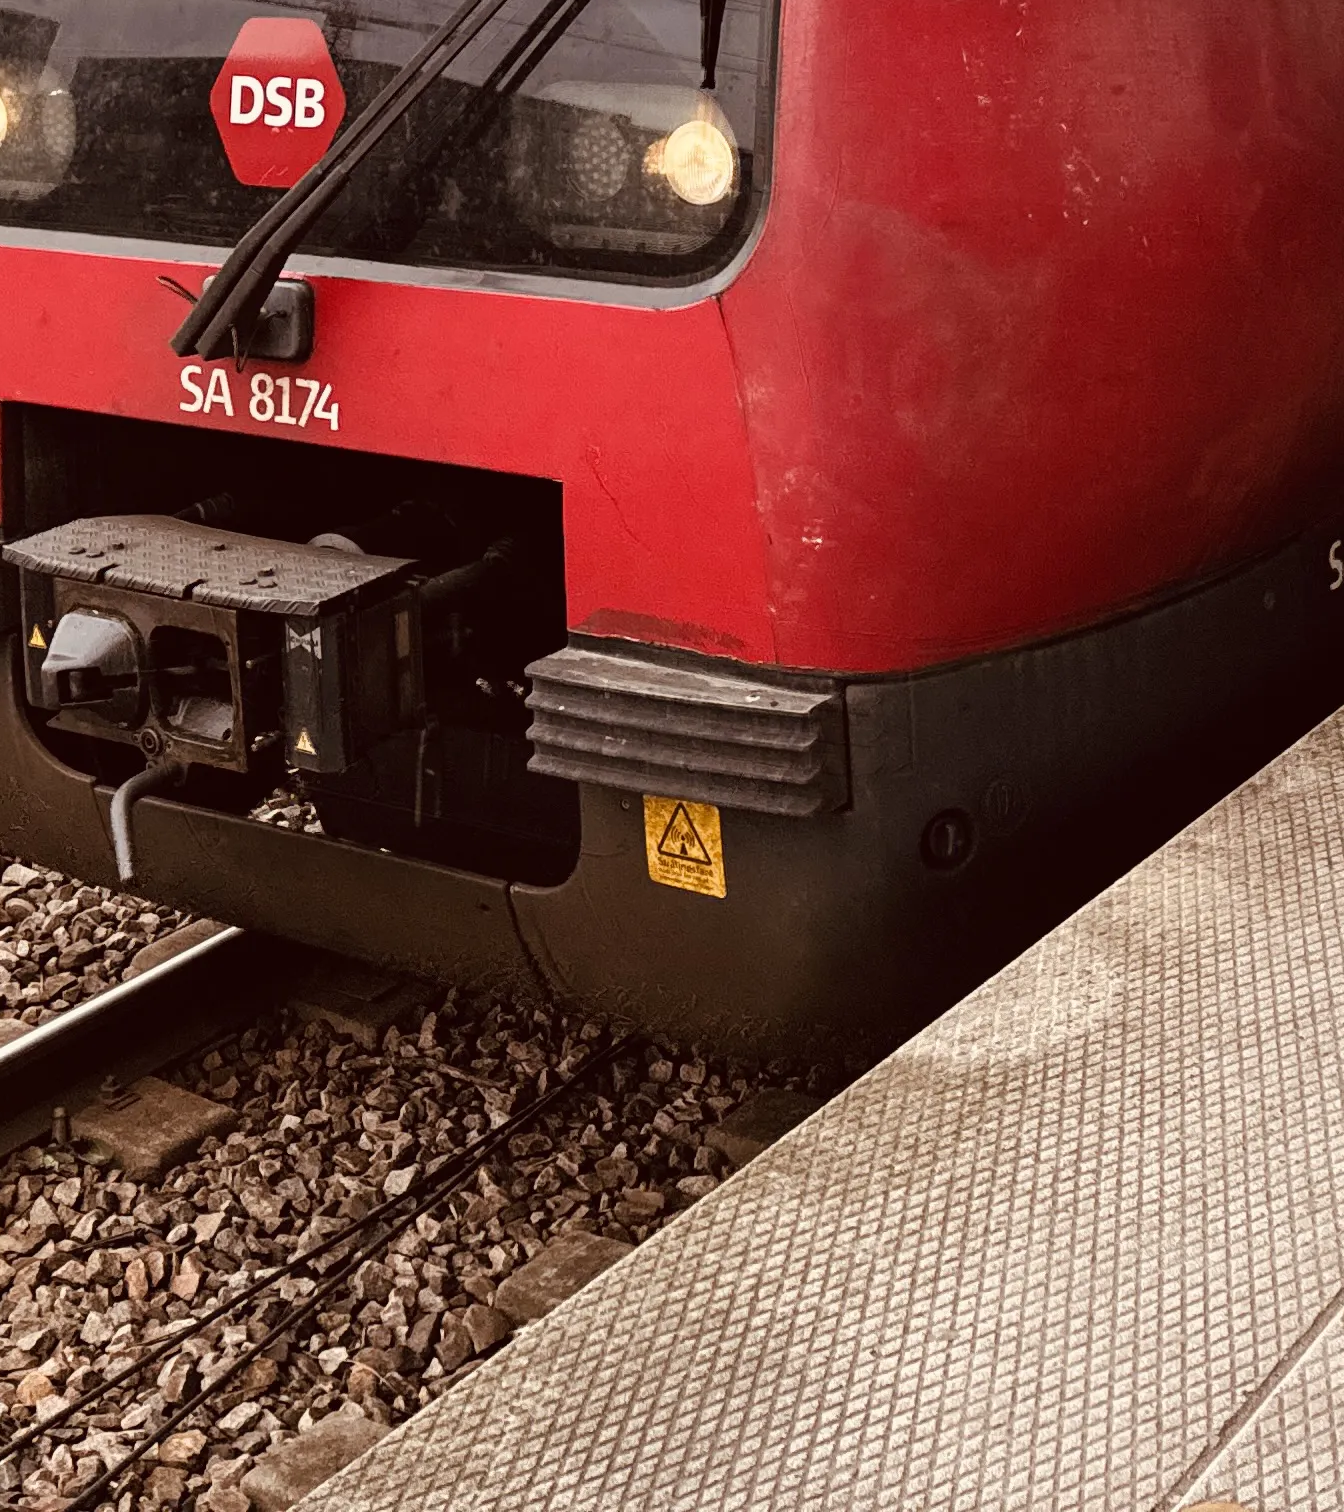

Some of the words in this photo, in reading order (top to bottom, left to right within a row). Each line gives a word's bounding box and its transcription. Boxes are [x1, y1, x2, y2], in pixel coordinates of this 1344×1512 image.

[230, 75, 325, 128] DSB
[179, 364, 235, 417] SA
[249, 372, 339, 431] 8174
